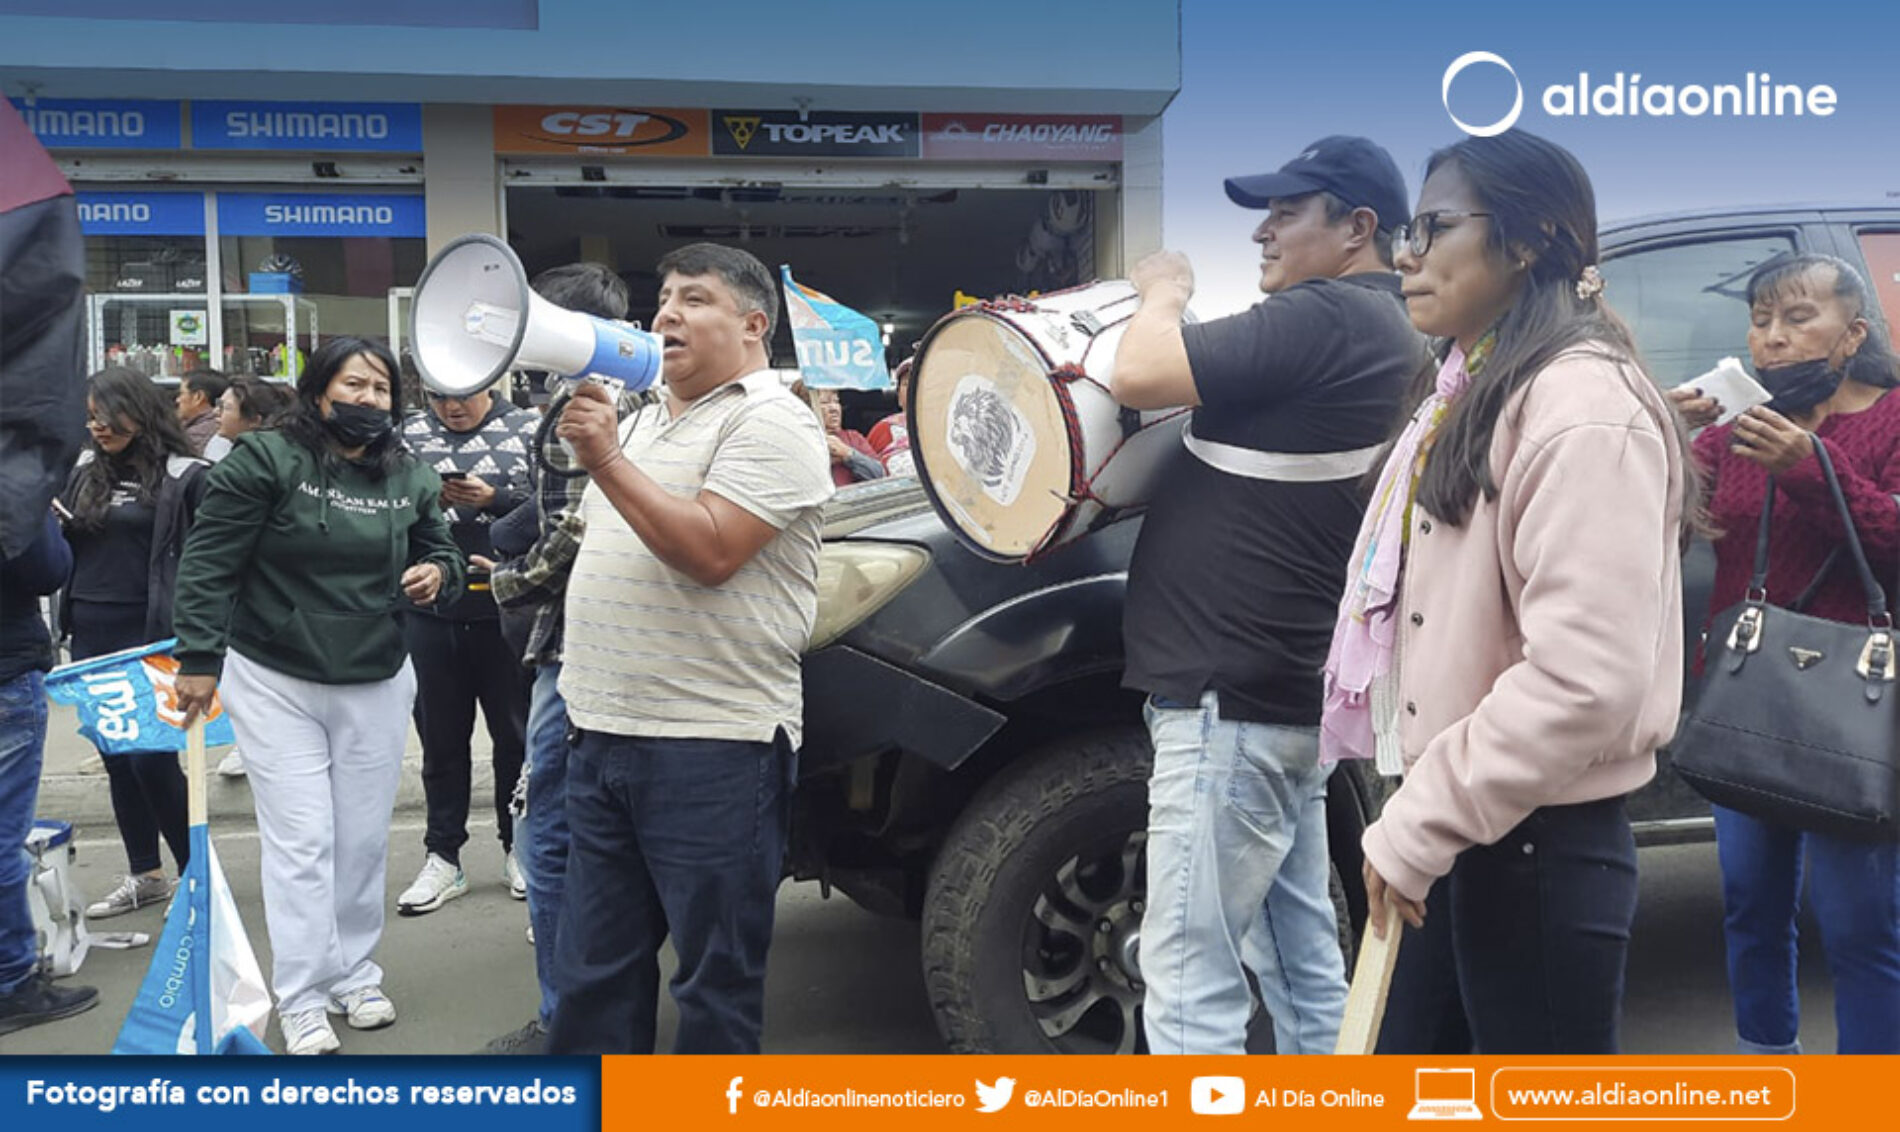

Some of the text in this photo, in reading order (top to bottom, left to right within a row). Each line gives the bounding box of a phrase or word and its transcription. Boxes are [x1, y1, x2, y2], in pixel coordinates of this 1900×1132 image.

[19, 109, 144, 137] IMANO
[226, 111, 389, 139] SHIMANO
[541, 112, 649, 137] CST
[762, 123, 905, 144] TOPEAK
[982, 123, 1113, 144] CHAOYANG
[264, 204, 393, 225] SHIMANO
[298, 481, 366, 507] AMRICAN
[158, 935, 194, 1009] cambio
